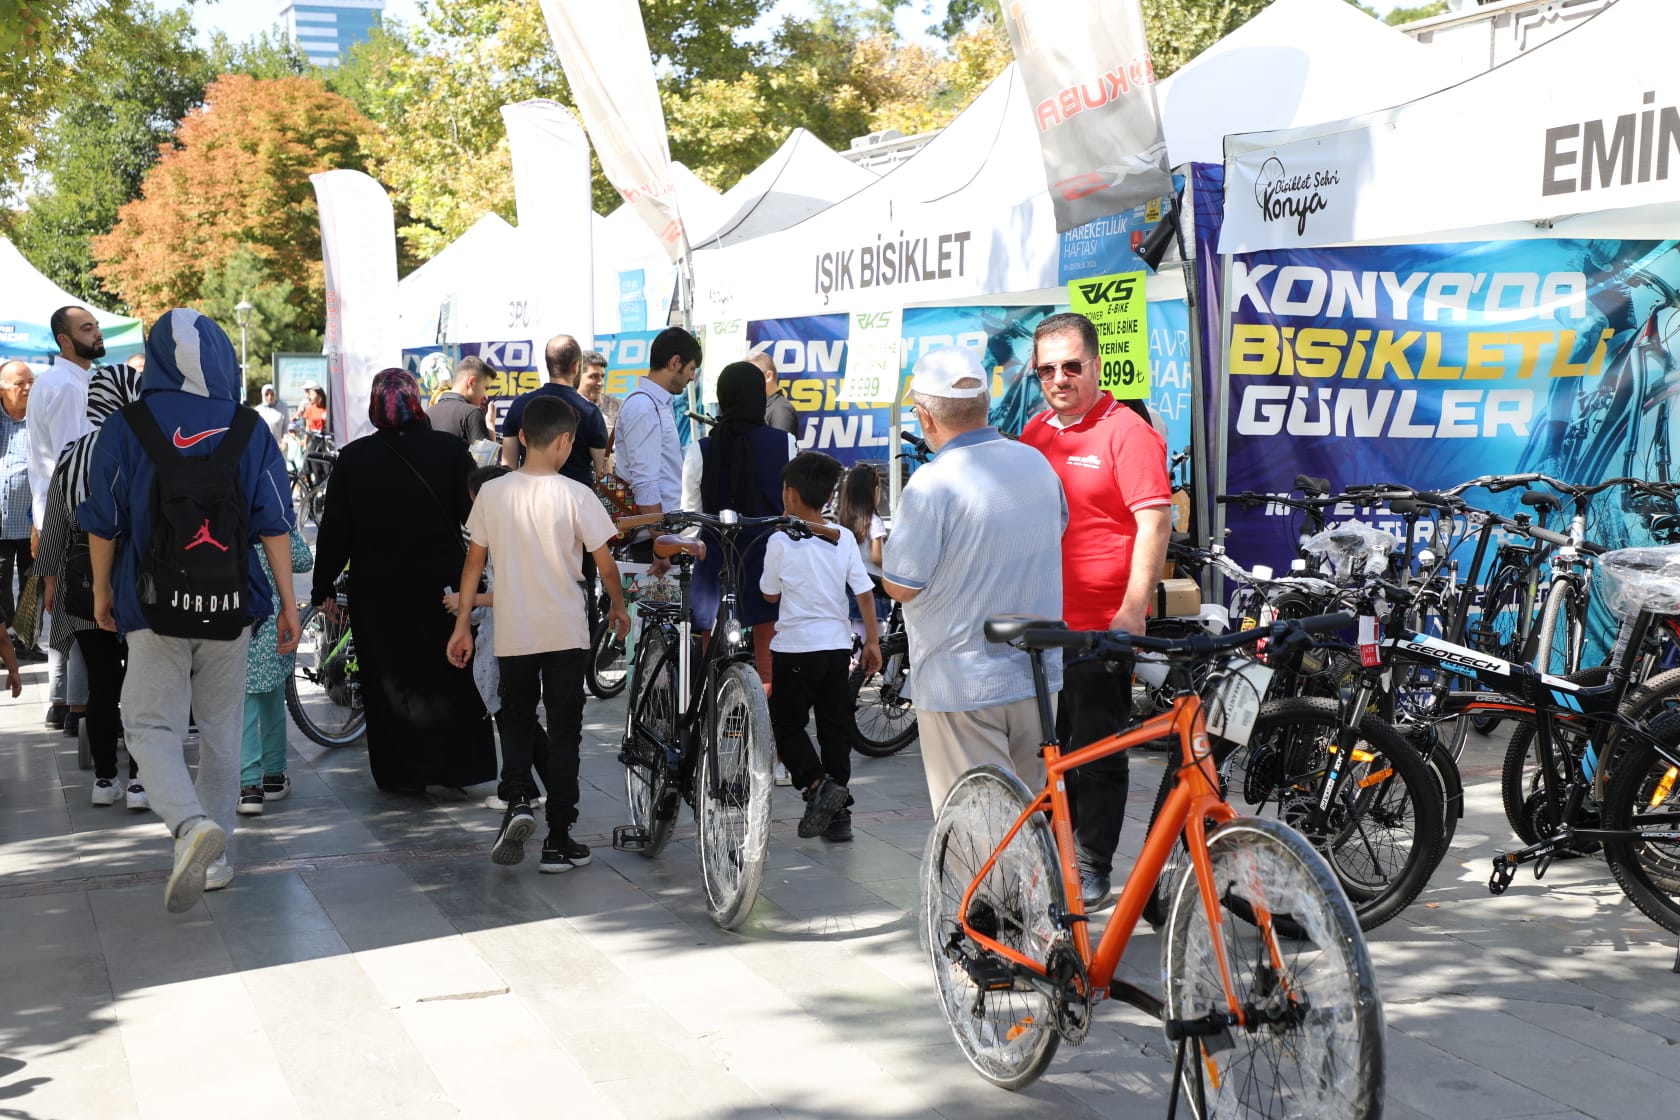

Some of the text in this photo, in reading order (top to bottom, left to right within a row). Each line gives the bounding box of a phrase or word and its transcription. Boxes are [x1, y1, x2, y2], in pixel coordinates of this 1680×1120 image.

[1263, 185, 1328, 237] Konya
[1064, 239, 1098, 258] HAFTASI
[815, 229, 971, 305] IŞIK BİSİKLET
[1078, 277, 1137, 304] RKS
[1231, 261, 1587, 321] KONYA'DA
[855, 310, 893, 330] RKS
[1100, 340, 1130, 356] YERİNE
[1229, 323, 1616, 381] BİSİKLETLİ
[1236, 384, 1534, 439] GÜNLER
[172, 590, 241, 613] JORDAN
[1406, 643, 1501, 671] GEOTECH
